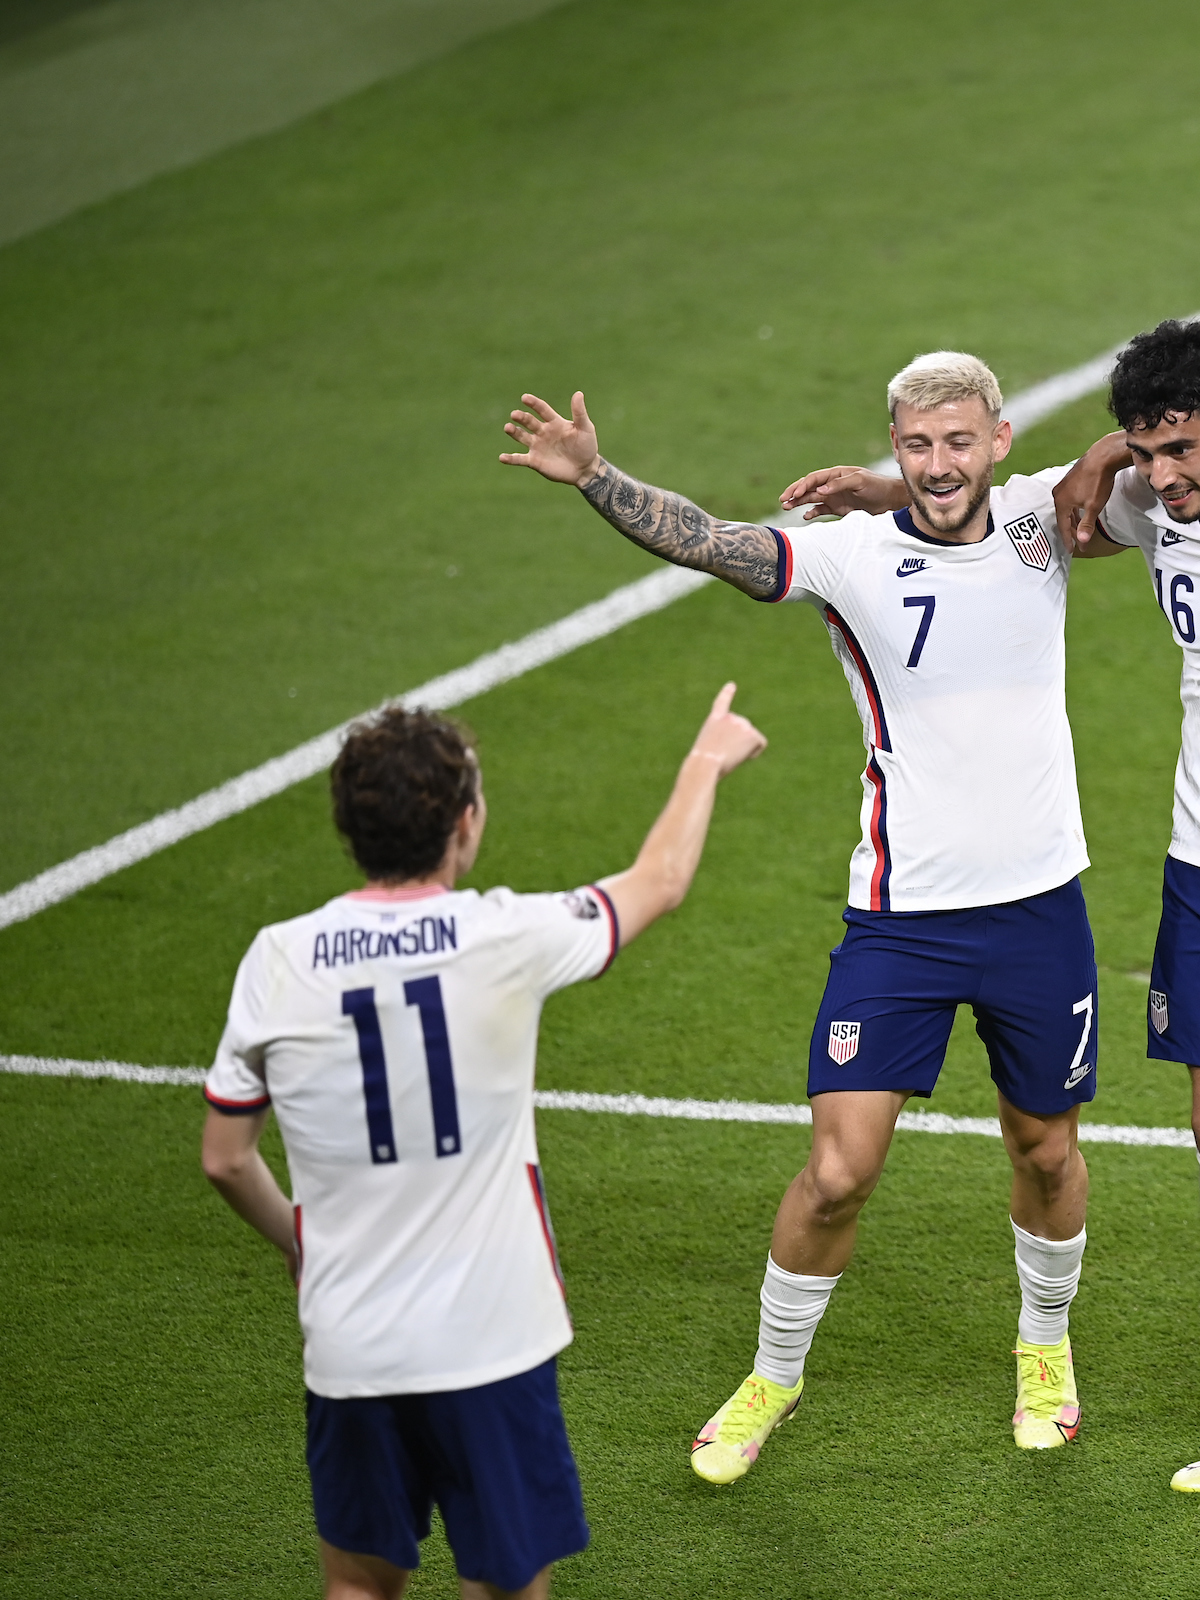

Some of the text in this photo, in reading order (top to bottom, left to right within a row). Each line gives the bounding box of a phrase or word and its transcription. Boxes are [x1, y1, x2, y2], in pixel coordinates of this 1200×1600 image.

[1009, 517, 1038, 541] USA
[901, 558, 927, 569] NIKE
[903, 595, 936, 668] 7
[1156, 568, 1196, 644] 16
[313, 915, 458, 970] AARONSON
[1151, 991, 1166, 1010] USA
[832, 1024, 858, 1040] USA
[1069, 991, 1094, 1070] 7
[341, 973, 463, 1165] 11
